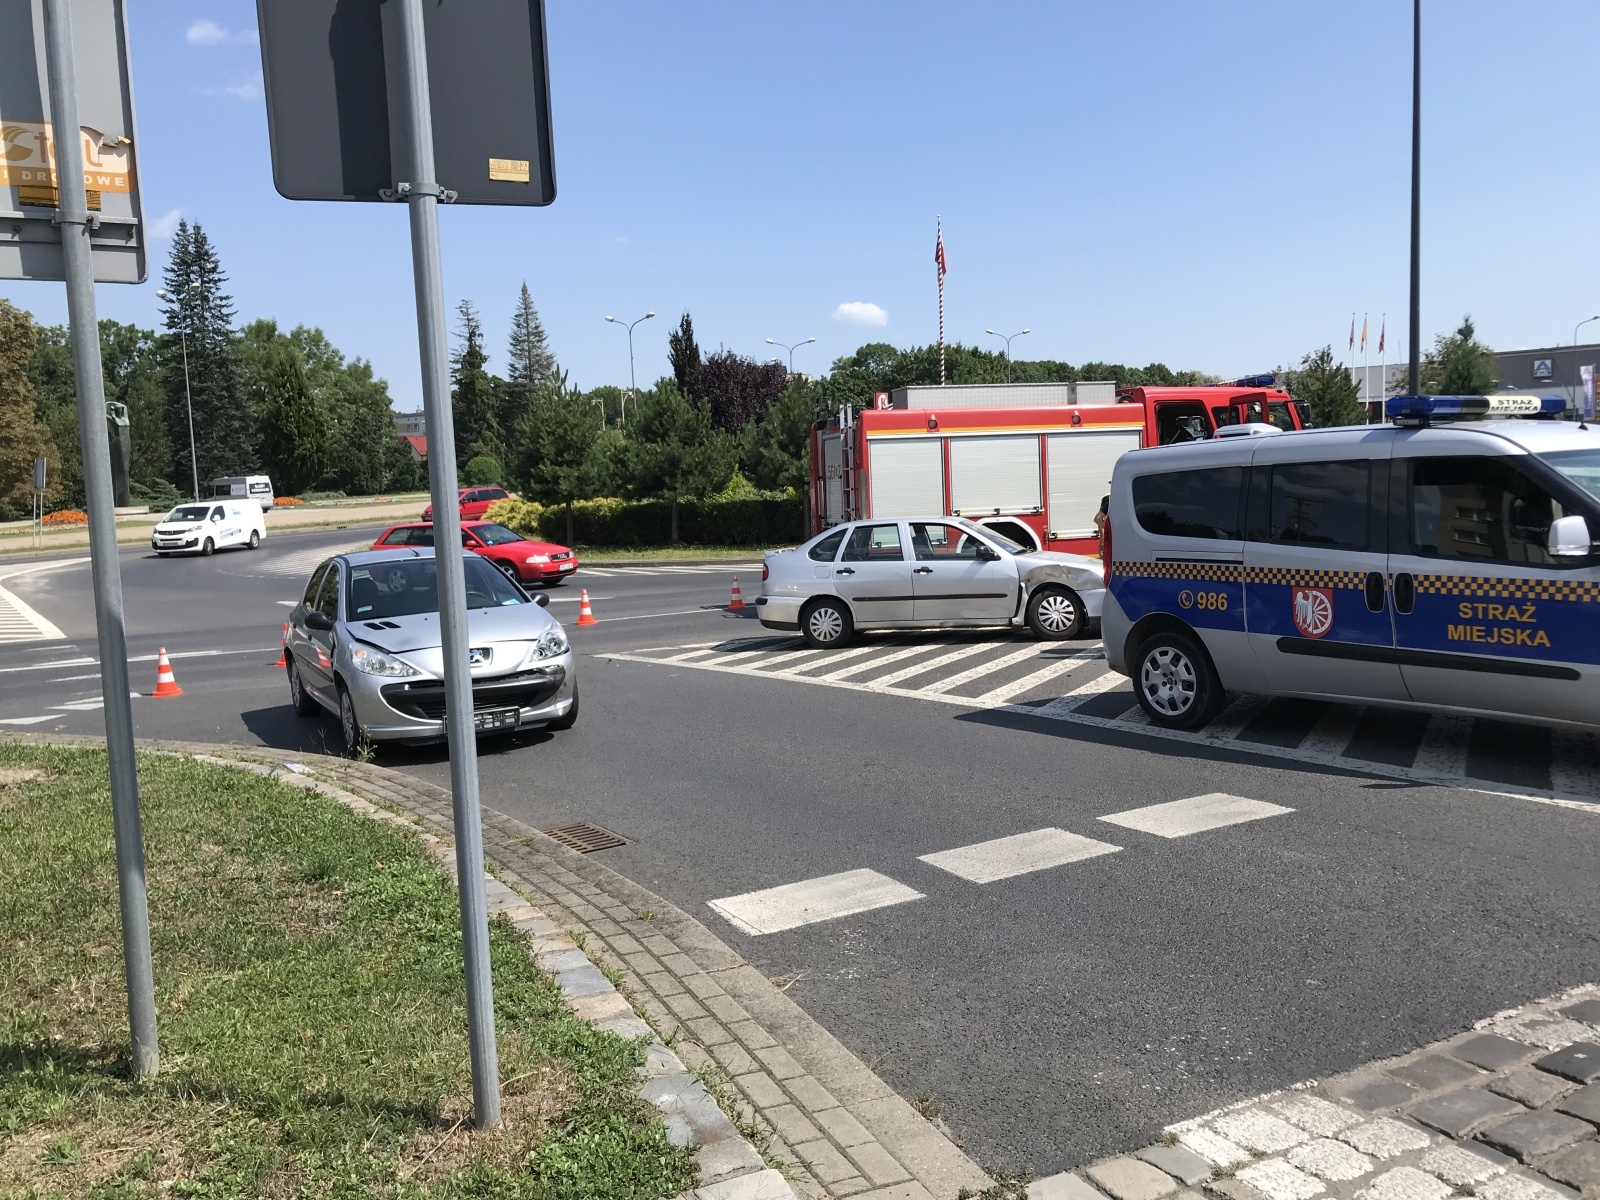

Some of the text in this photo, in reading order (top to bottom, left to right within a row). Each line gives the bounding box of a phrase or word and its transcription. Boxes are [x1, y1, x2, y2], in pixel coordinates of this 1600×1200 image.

[22, 170, 125, 187] DROWE
[1197, 591, 1228, 611] 986
[1458, 602, 1537, 623] STRAŻ
[1447, 624, 1551, 648] MIEJSKA
